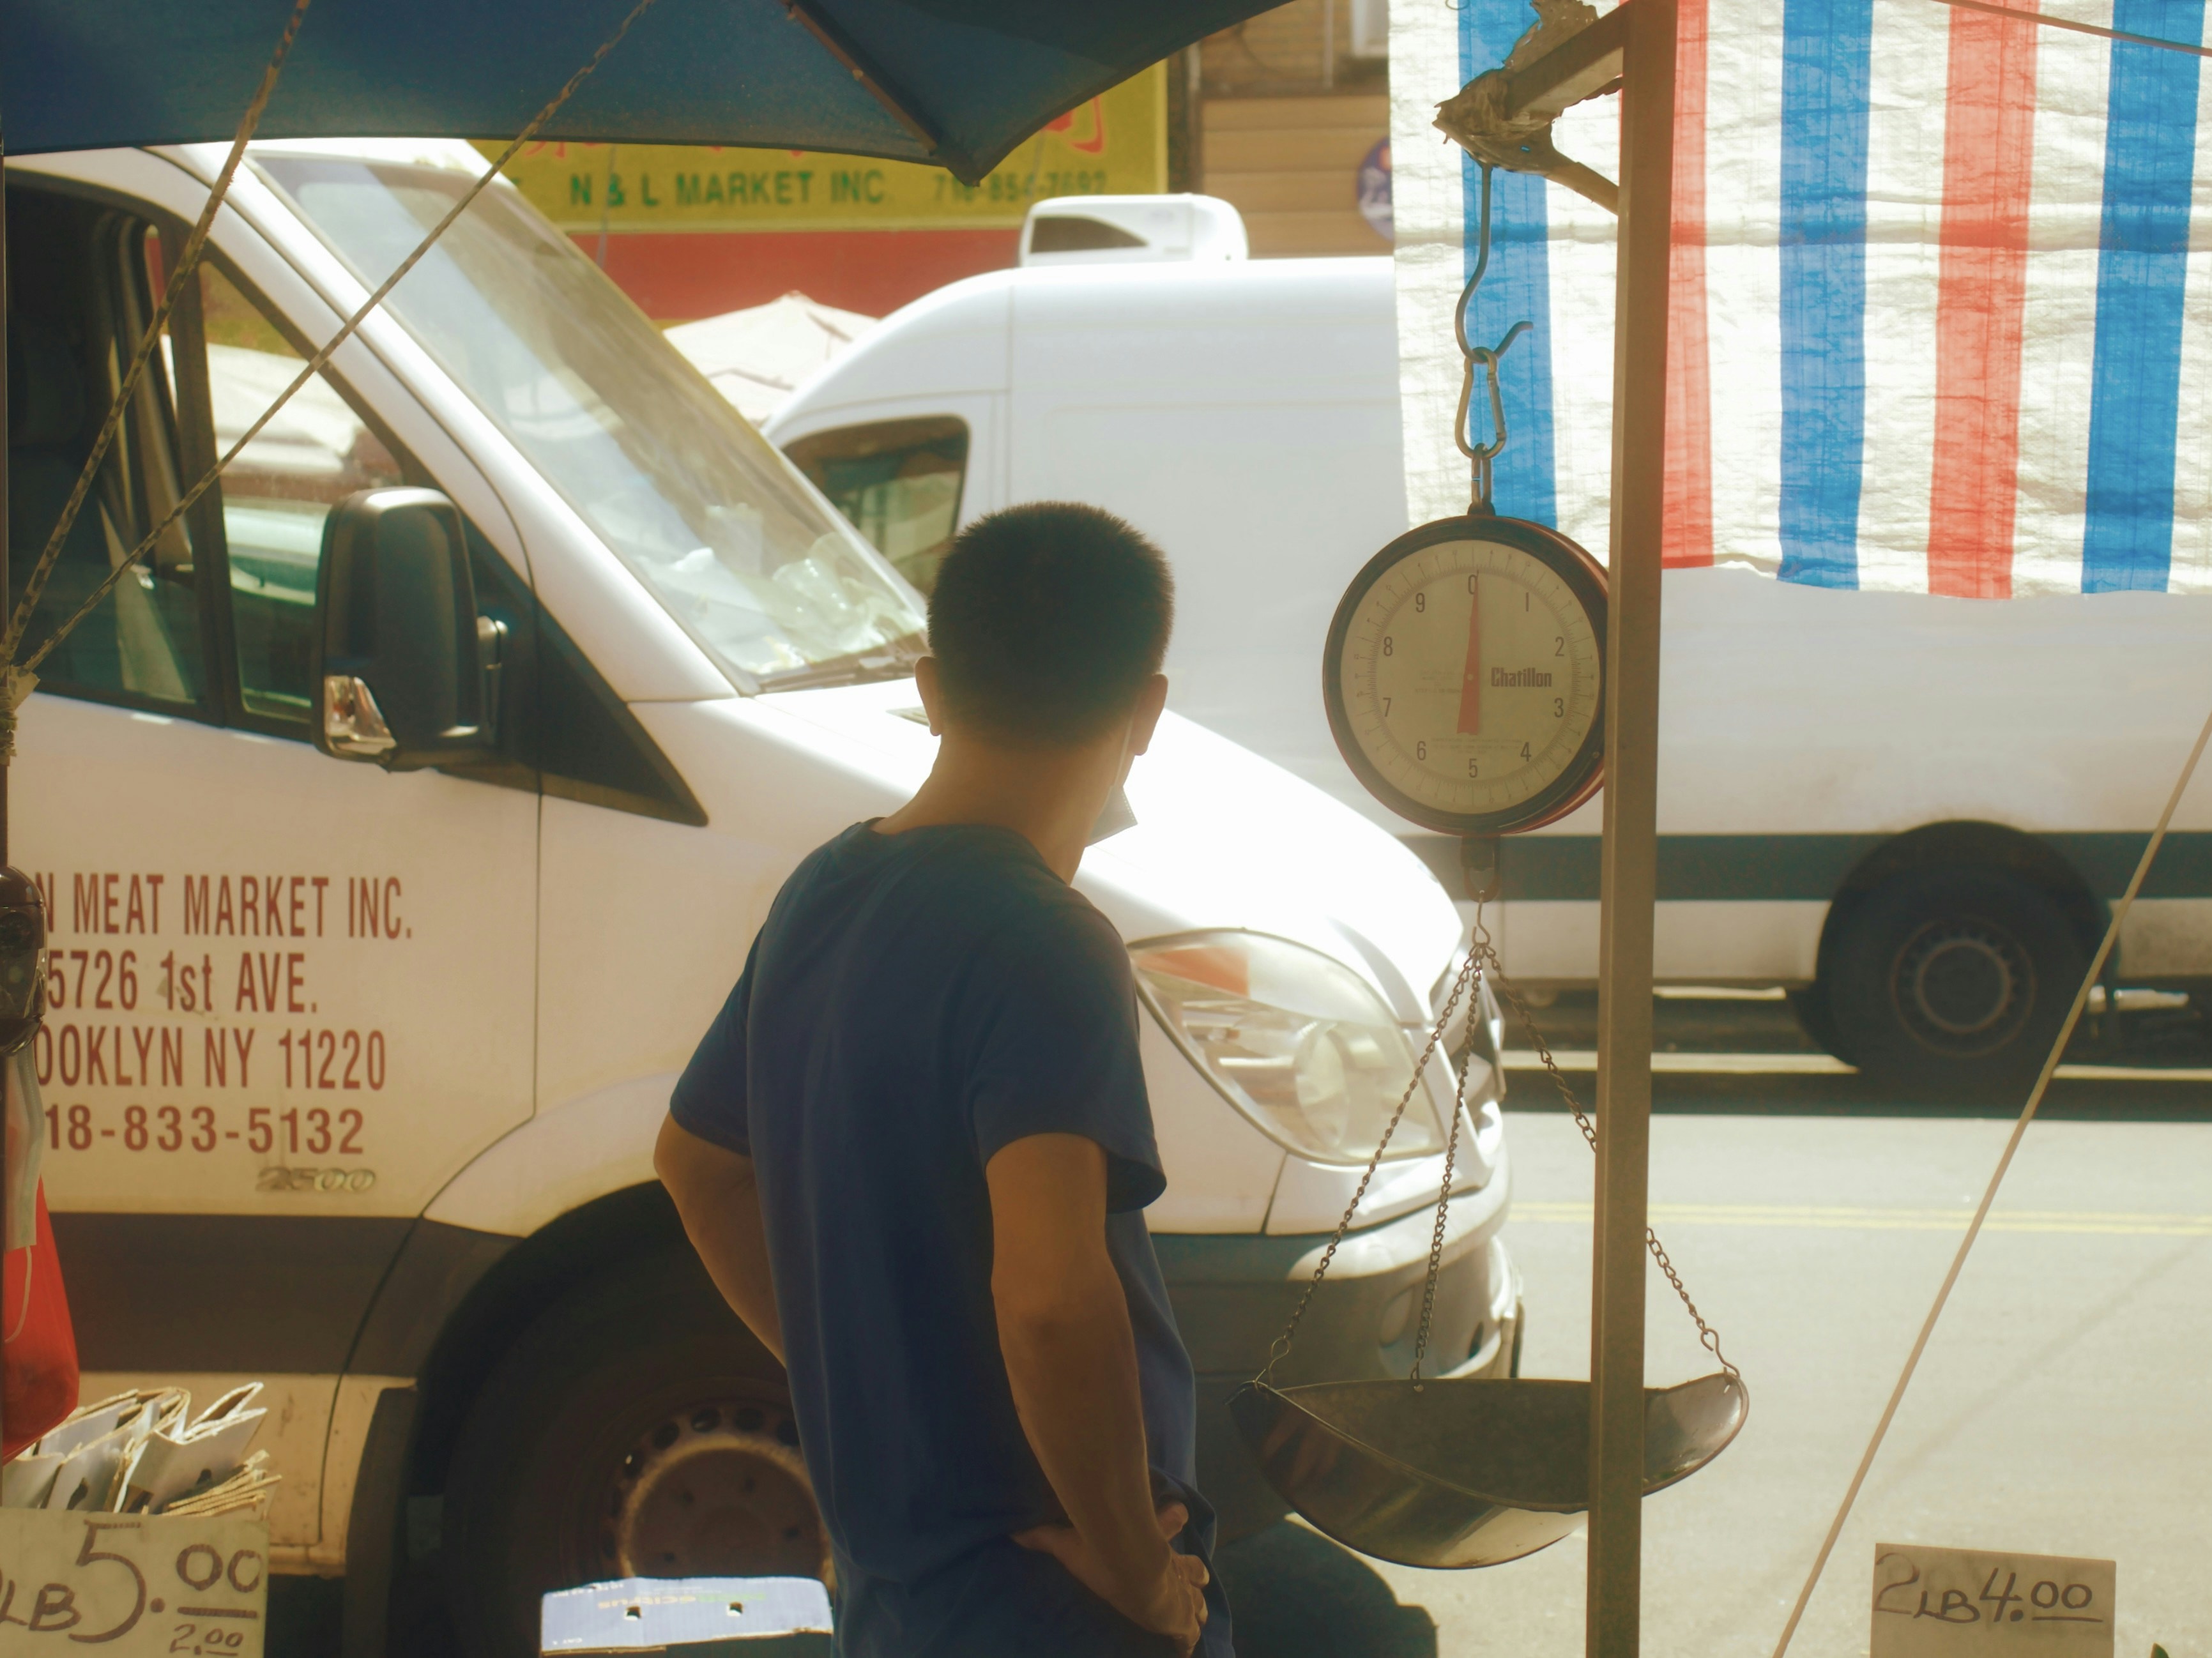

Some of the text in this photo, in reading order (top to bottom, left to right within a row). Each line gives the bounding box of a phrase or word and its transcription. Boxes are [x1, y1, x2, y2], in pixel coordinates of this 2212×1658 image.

[570, 173, 591, 206] N
[607, 172, 625, 207] &
[641, 173, 659, 206] L
[675, 171, 813, 206] MARKET
[1468, 574, 1478, 595] 0
[1415, 593, 1426, 612] 9
[1525, 592, 1529, 612] 1
[1383, 636, 1393, 657] 8
[1555, 636, 1564, 657] 2
[1491, 667, 1552, 688] Chatillon
[1382, 697, 1392, 717] 7
[1554, 697, 1564, 718] 3
[1416, 740, 1427, 761] 6
[1520, 742, 1532, 762] 4
[1468, 758, 1478, 778] 5
[73, 872, 164, 935] MEAT
[183, 874, 329, 938] MARKET
[348, 877, 411, 939] INC.
[47, 949, 317, 1014] 5726 1st AVE.
[204, 1027, 255, 1088] NY
[278, 1029, 386, 1091] 11220
[255, 1166, 376, 1192] 2500
[68, 1519, 263, 1644] 5.00
[1979, 1567, 2093, 1623] 4.00
[169, 1624, 244, 1655] 2.00
